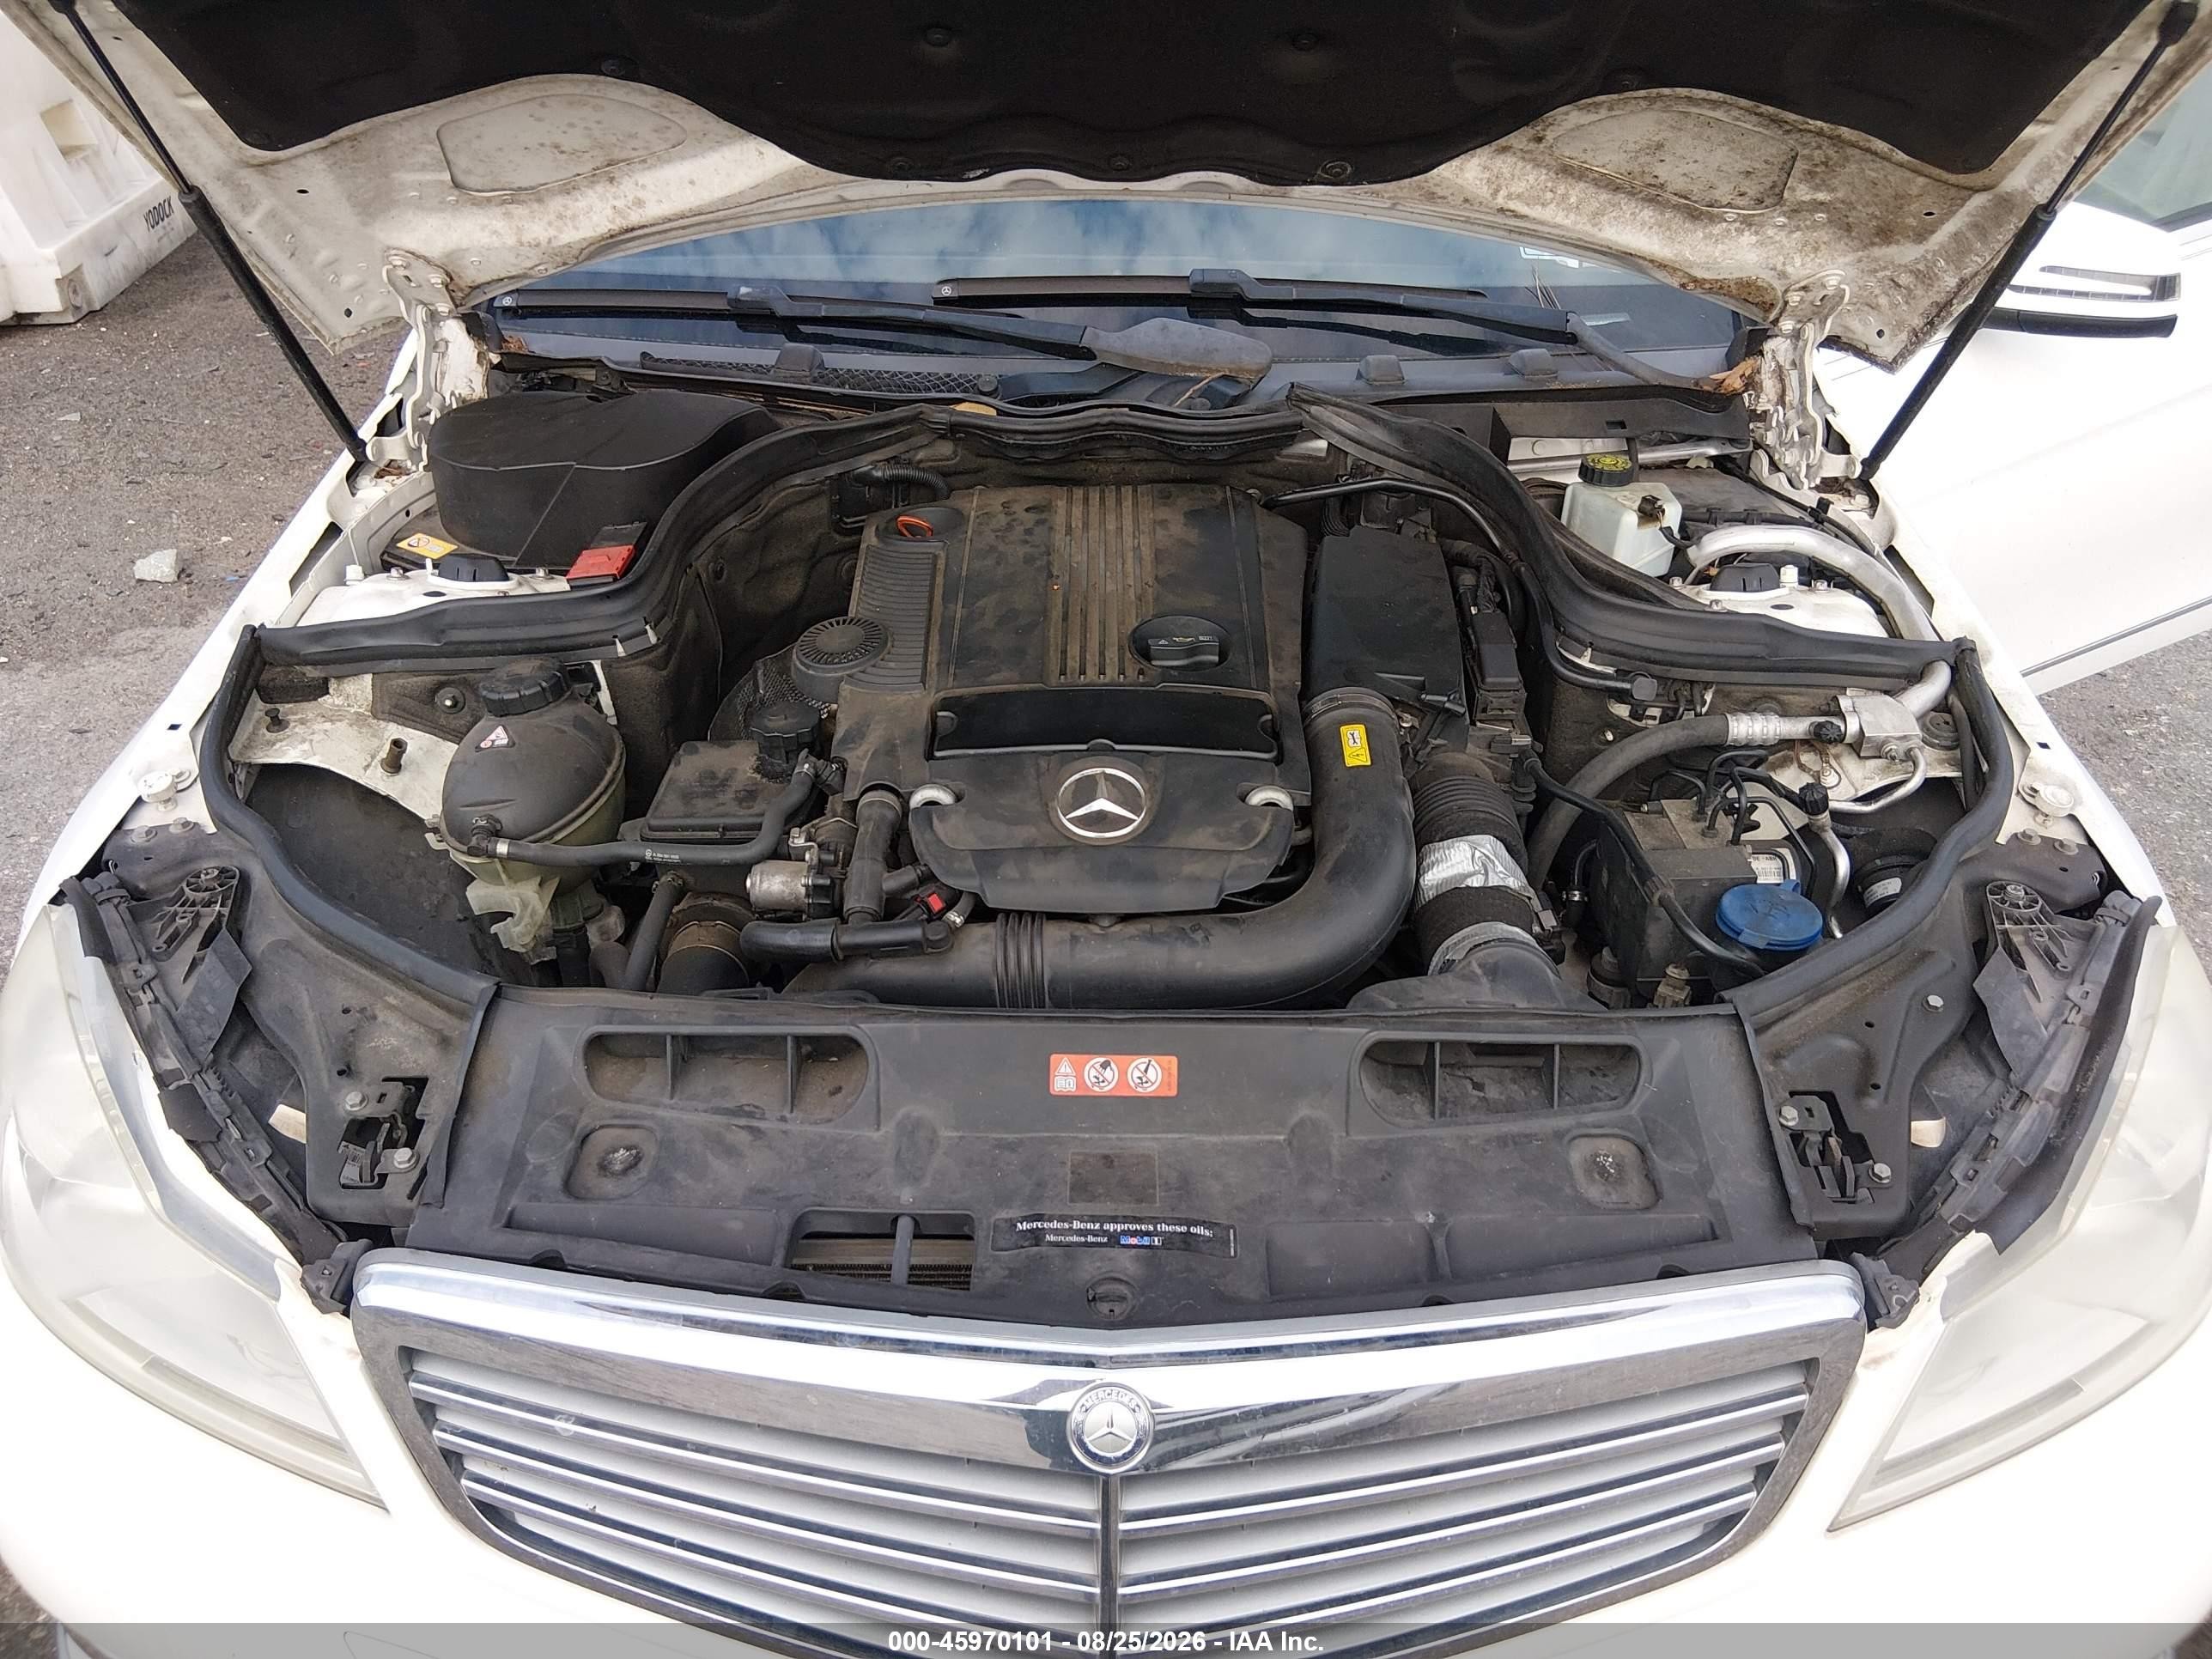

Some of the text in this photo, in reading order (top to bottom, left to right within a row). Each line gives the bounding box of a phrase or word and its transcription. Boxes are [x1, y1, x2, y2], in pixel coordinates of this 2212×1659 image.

[143, 196, 174, 233] YODOCK
[1016, 1220, 1213, 1237] Mercedes-Benz approves these oils:
[1045, 1234, 1108, 1243] Mercedes-Benz
[1120, 1235, 1151, 1245] Mobil
[1085, 1389, 1136, 1408] MERCEDES
